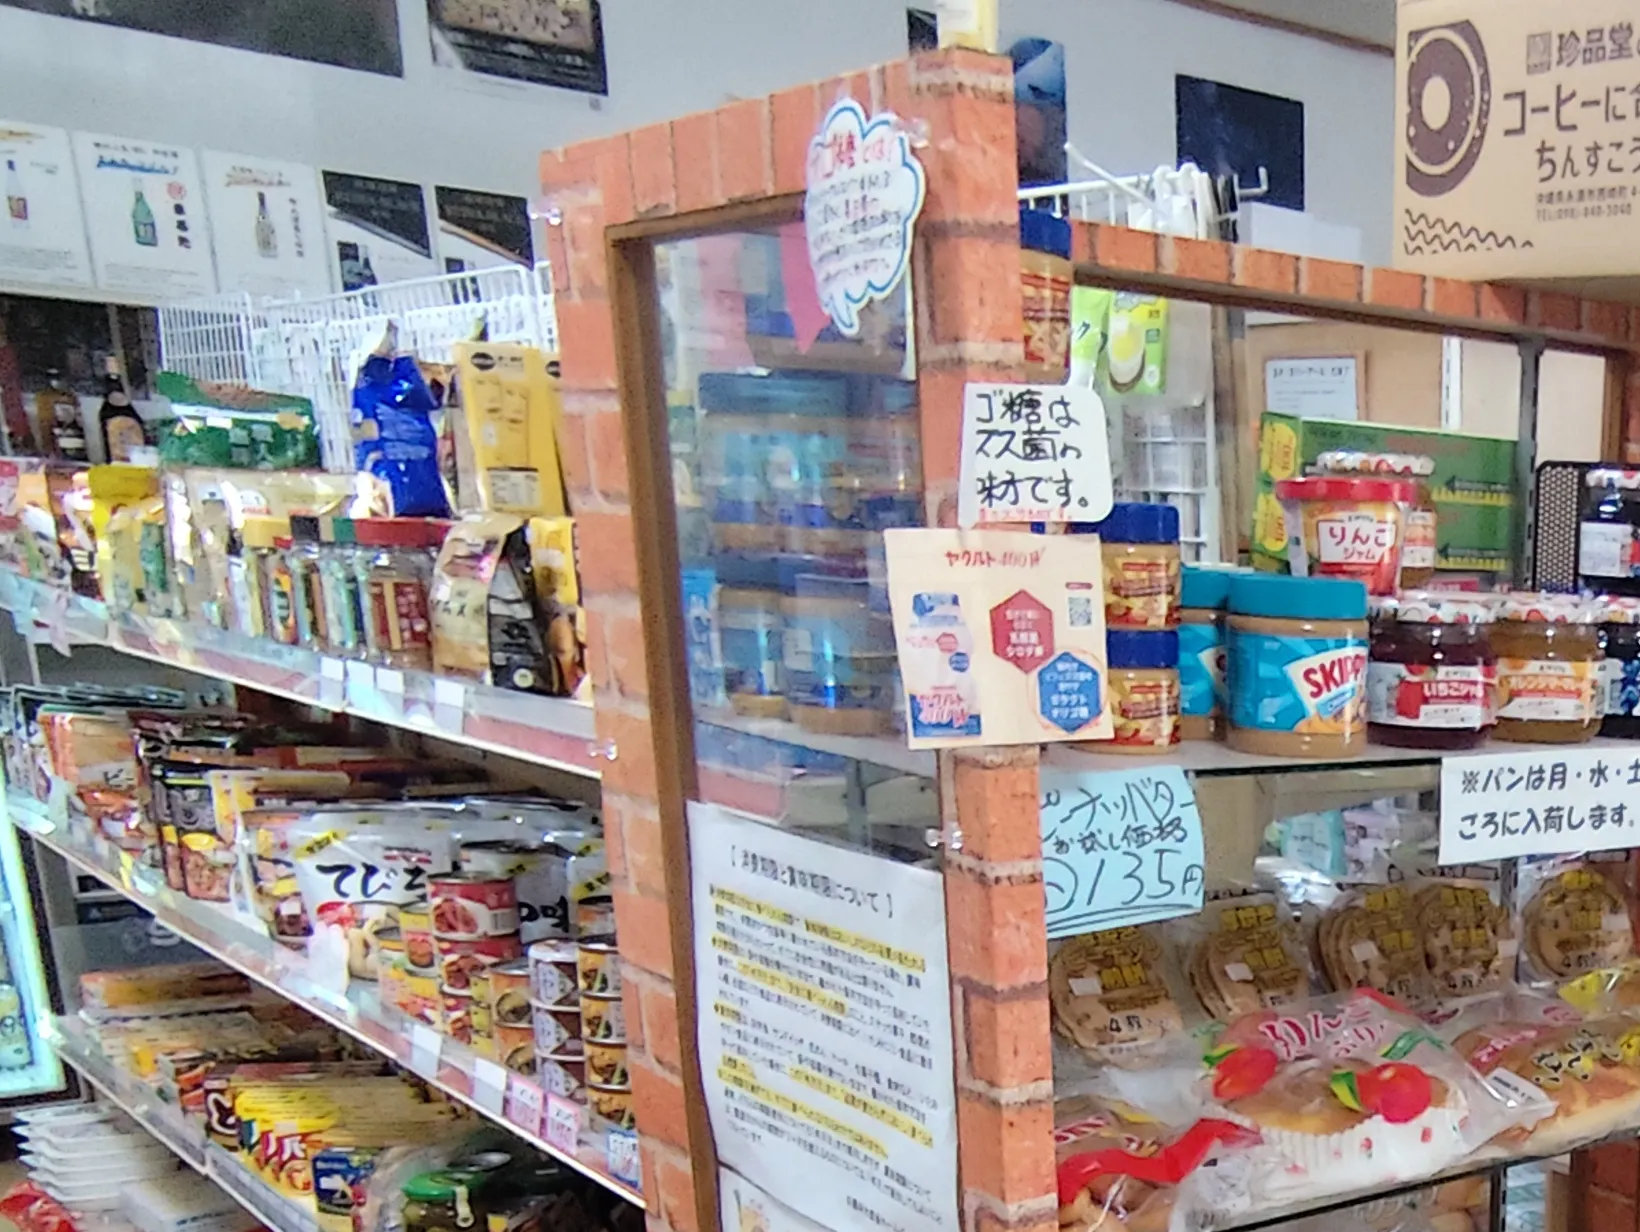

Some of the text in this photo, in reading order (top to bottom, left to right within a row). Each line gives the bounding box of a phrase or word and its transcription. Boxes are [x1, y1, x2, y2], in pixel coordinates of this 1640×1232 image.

[944, 550, 995, 568] ヤクルト
[1458, 802, 1636, 841] ころに入荷します。
